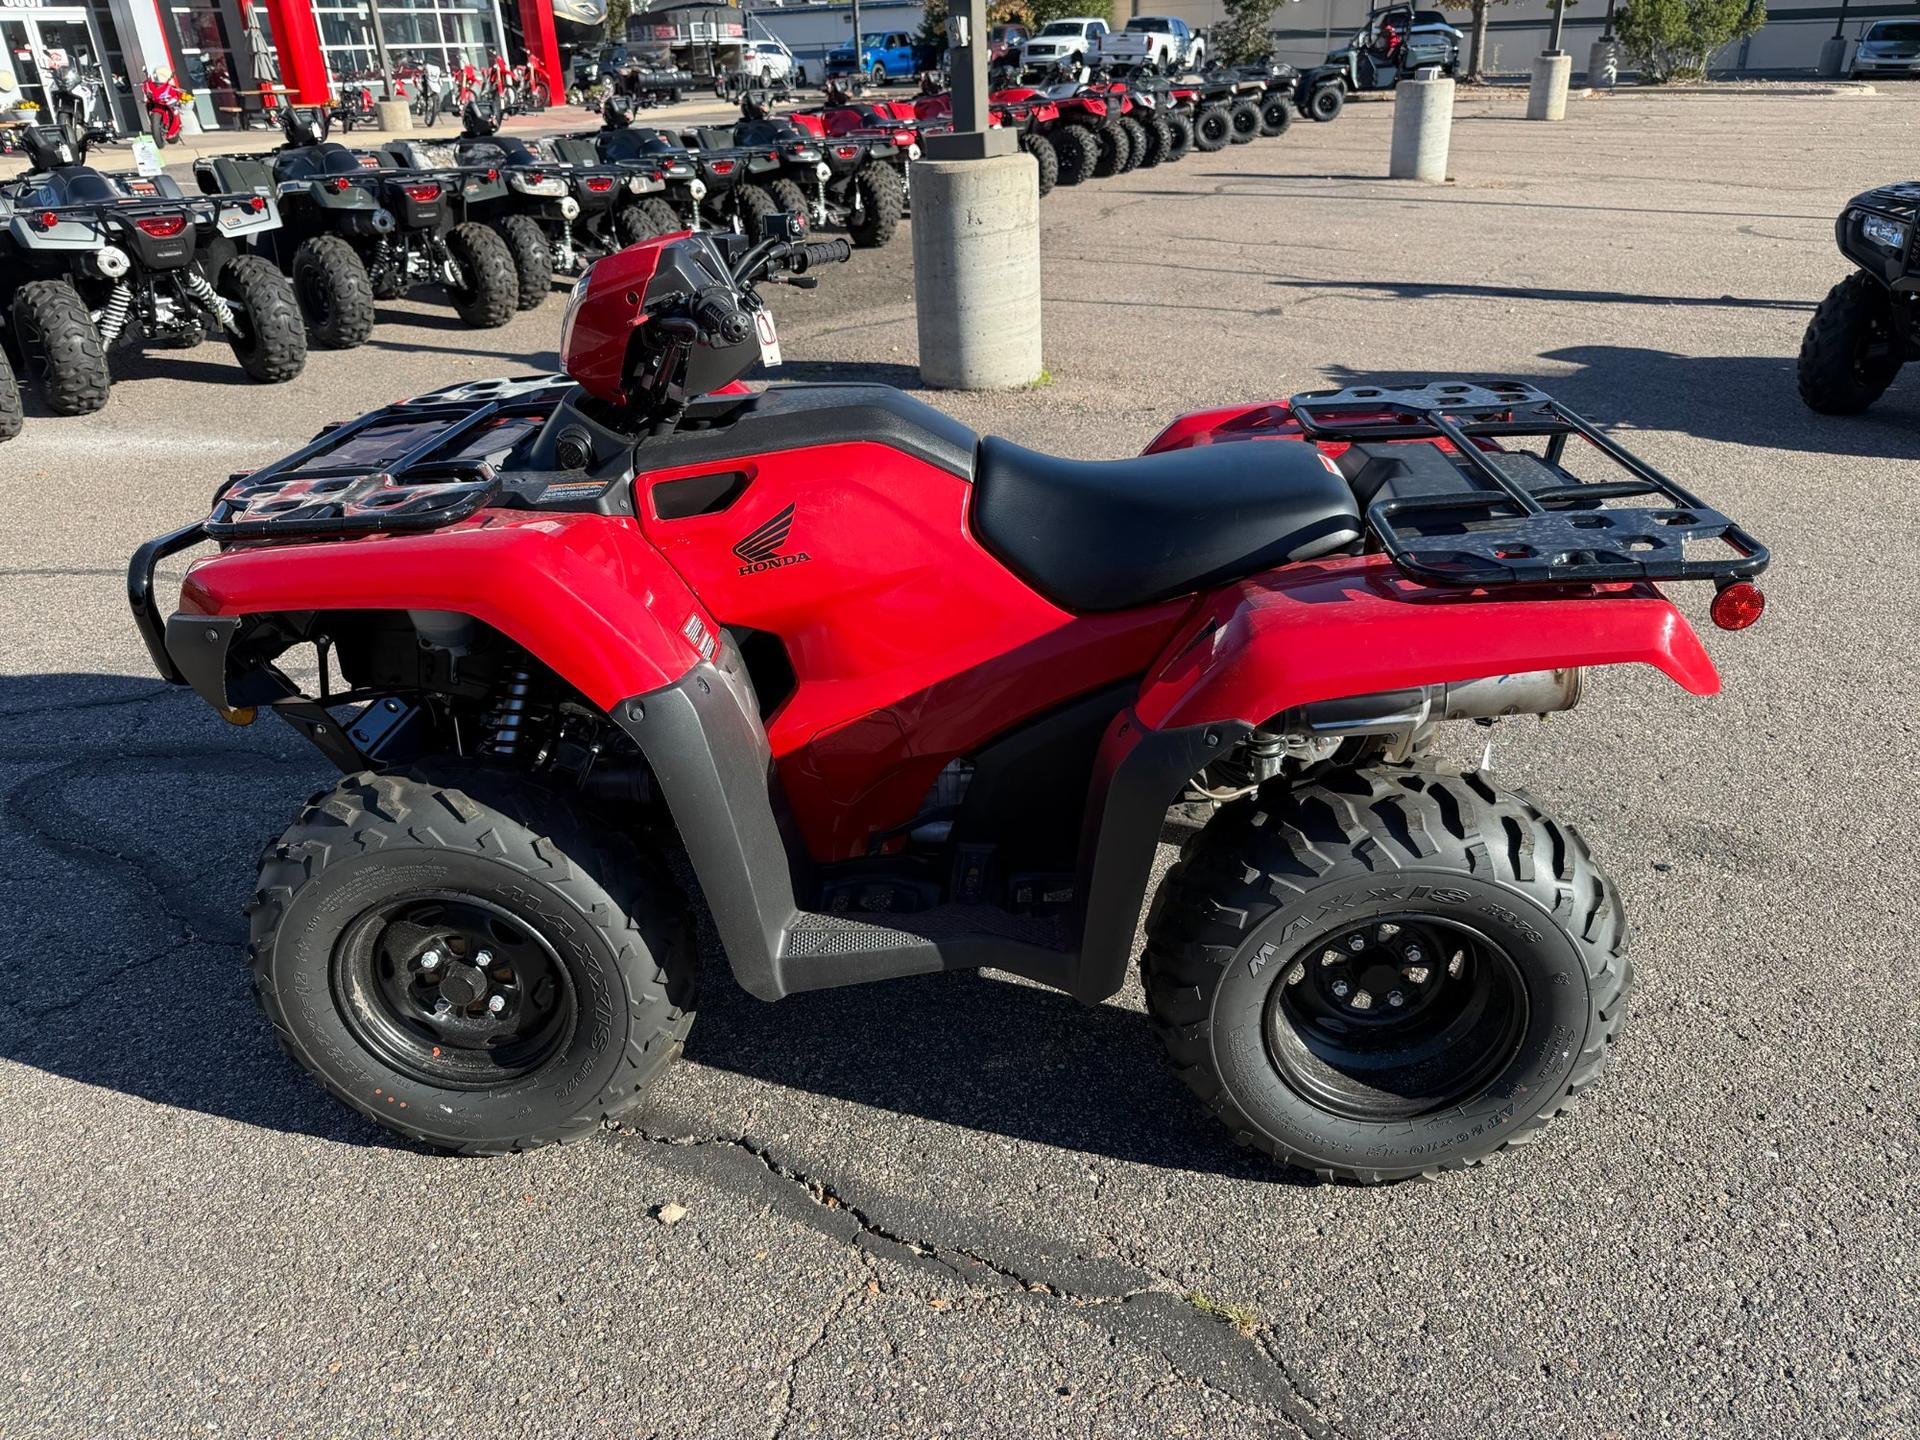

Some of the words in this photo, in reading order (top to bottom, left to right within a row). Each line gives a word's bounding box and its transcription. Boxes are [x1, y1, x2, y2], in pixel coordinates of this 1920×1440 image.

[738, 552, 811, 576] HONDA
[495, 885, 613, 1053] MAXXIS
[1248, 884, 1472, 979] MAXXIS
